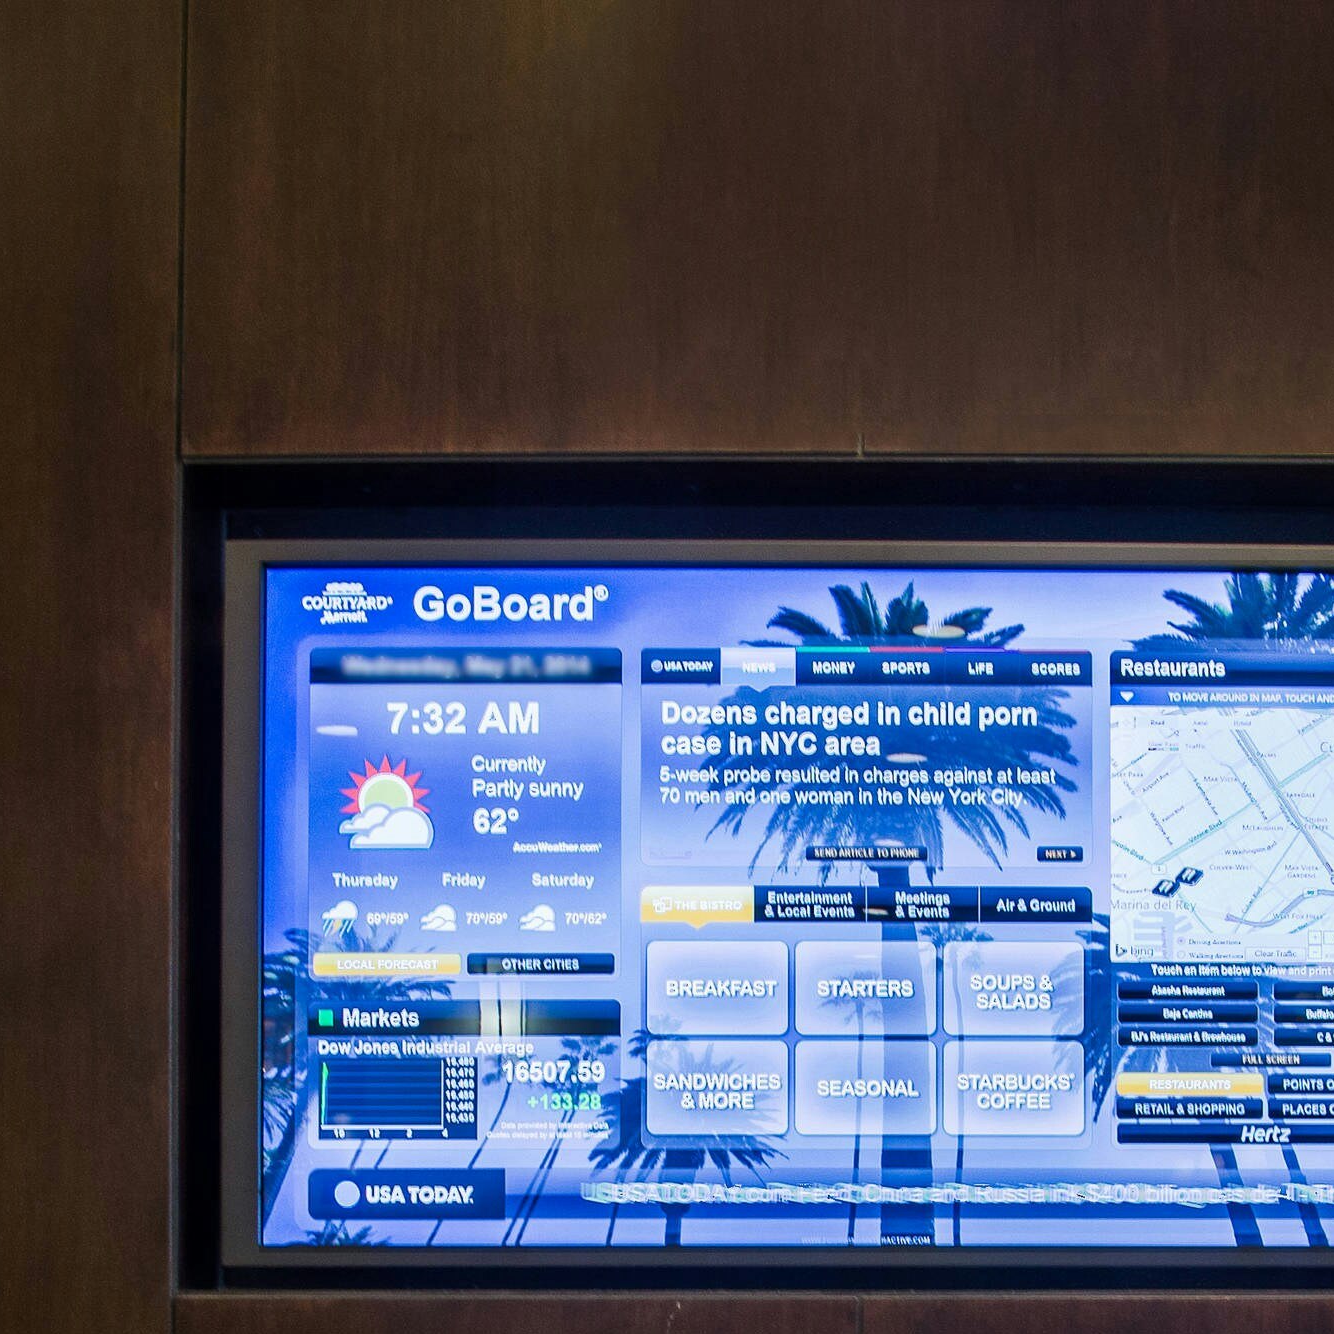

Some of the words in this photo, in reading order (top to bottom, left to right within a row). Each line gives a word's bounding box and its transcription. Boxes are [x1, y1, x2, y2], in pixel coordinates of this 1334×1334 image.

[742, 662, 776, 673] NEWS
[812, 661, 856, 675] MONEY
[882, 662, 930, 675] SPORTS
[968, 662, 994, 676] LIFE
[1031, 662, 1081, 676] SCORES
[1120, 659, 1226, 677] Restaurants
[1168, 692, 1183, 702] TO
[1186, 692, 1208, 702] MOVE
[1209, 692, 1247, 702] AROUND
[1249, 693, 1260, 703] IN
[1286, 693, 1316, 703] TOUCH
[387, 701, 466, 734] 7:32
[478, 701, 539, 734] AM
[661, 701, 757, 725] Dozens
[764, 701, 869, 730] charged
[877, 701, 901, 726] in
[908, 701, 971, 726] child
[978, 706, 1038, 732] porn
[660, 735, 722, 755] case
[729, 731, 753, 755] in
[760, 731, 817, 756] NYC
[824, 735, 881, 756] area
[471, 755, 546, 776] Currently
[659, 765, 719, 783] 5-week
[723, 765, 770, 786] probe
[775, 765, 841, 783] resulted
[844, 765, 859, 783] in
[863, 766, 929, 787] charges
[933, 766, 993, 787] against
[997, 767, 1013, 784] at
[1017, 766, 1056, 784] least
[472, 778, 524, 800] Partly
[529, 782, 584, 800] sunny
[659, 787, 680, 804] 70
[684, 790, 720, 804] men
[724, 788, 755, 804] and
[759, 790, 790, 804] one
[794, 790, 854, 804] woman
[858, 788, 873, 805] in
[877, 788, 903, 805] the
[907, 788, 944, 805] New
[949, 788, 986, 805] York
[991, 788, 1027, 808] City.
[473, 807, 519, 834] 62°
[890, 847, 919, 858] PHONE
[1045, 849, 1068, 859] NEXT
[332, 872, 398, 889] Thursday
[442, 872, 486, 889] Friday
[532, 872, 594, 889] Saturday
[675, 900, 698, 911] THE
[700, 900, 742, 911] BISTRO
[767, 891, 852, 905] Entertainment
[895, 891, 950, 907] Meetings
[996, 898, 1015, 912] Air
[1017, 899, 1027, 912] &
[1030, 898, 1076, 912] Ground
[765, 905, 774, 917] &
[777, 904, 810, 918] Local
[814, 904, 855, 918] Events
[895, 905, 905, 918] &
[908, 905, 950, 918] Events
[337, 959, 375, 970] LOCAL
[378, 959, 438, 970] FORECAST
[501, 958, 541, 970] OTHER
[543, 958, 579, 970] CITIES
[1151, 964, 1182, 976] Touch
[1198, 964, 1219, 976] item
[1221, 965, 1251, 976] below
[1252, 966, 1262, 976] to
[1264, 965, 1286, 976] view
[1288, 966, 1306, 976] and
[1309, 966, 1332, 978] print
[665, 979, 777, 998] BREAKFAST
[817, 979, 914, 999] STARTERS
[970, 974, 1035, 992] SOUPS
[1038, 974, 1055, 992] &
[976, 993, 1053, 1011] SALADS
[342, 1008, 419, 1027] Markets
[318, 1040, 351, 1055] Dow
[355, 1040, 400, 1055] Jones
[402, 1040, 470, 1055] Industrial
[475, 1041, 534, 1058] Average
[502, 1060, 605, 1083] 16507.59
[653, 1073, 782, 1091] SANDWICHES
[816, 1079, 920, 1098] SEASONAL
[1149, 1079, 1231, 1090] RESTAURANTS
[1283, 1078, 1324, 1091] POINTS
[528, 1093, 602, 1110] +133.28
[680, 1093, 696, 1110] &
[699, 1093, 756, 1110] MORE
[976, 1093, 1053, 1110] COFFEE
[1135, 1103, 1174, 1115] RETAIL
[1176, 1103, 1184, 1115] &
[1187, 1103, 1245, 1115] SHOPPING
[1282, 1103, 1326, 1116] PLACES
[1241, 1125, 1291, 1143] Hertz
[365, 1185, 406, 1204] USA
